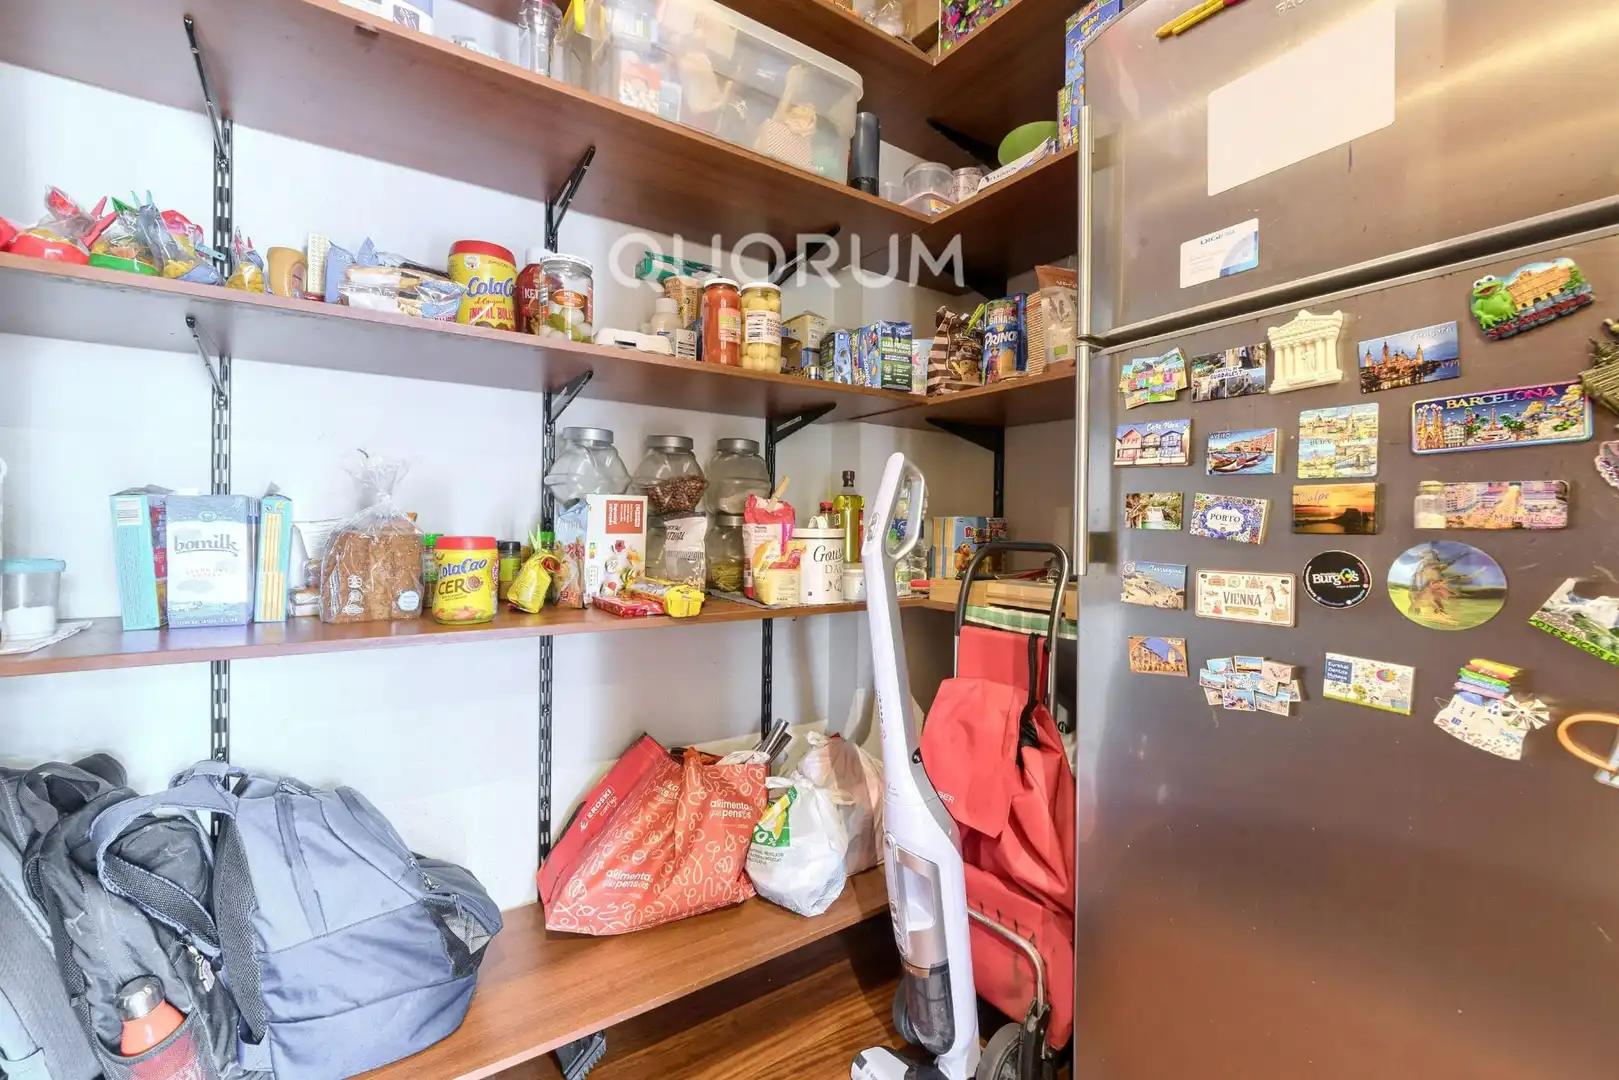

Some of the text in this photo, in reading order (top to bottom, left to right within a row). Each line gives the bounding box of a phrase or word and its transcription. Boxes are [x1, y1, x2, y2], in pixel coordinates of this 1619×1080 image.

[1446, 386, 1559, 409] BARCELONA
[1210, 513, 1241, 523] PORTO
[1312, 568, 1360, 586] Burgos
[1223, 591, 1263, 608] VIENNA
[586, 789, 612, 819] EROSKI
[937, 791, 955, 803] SER
